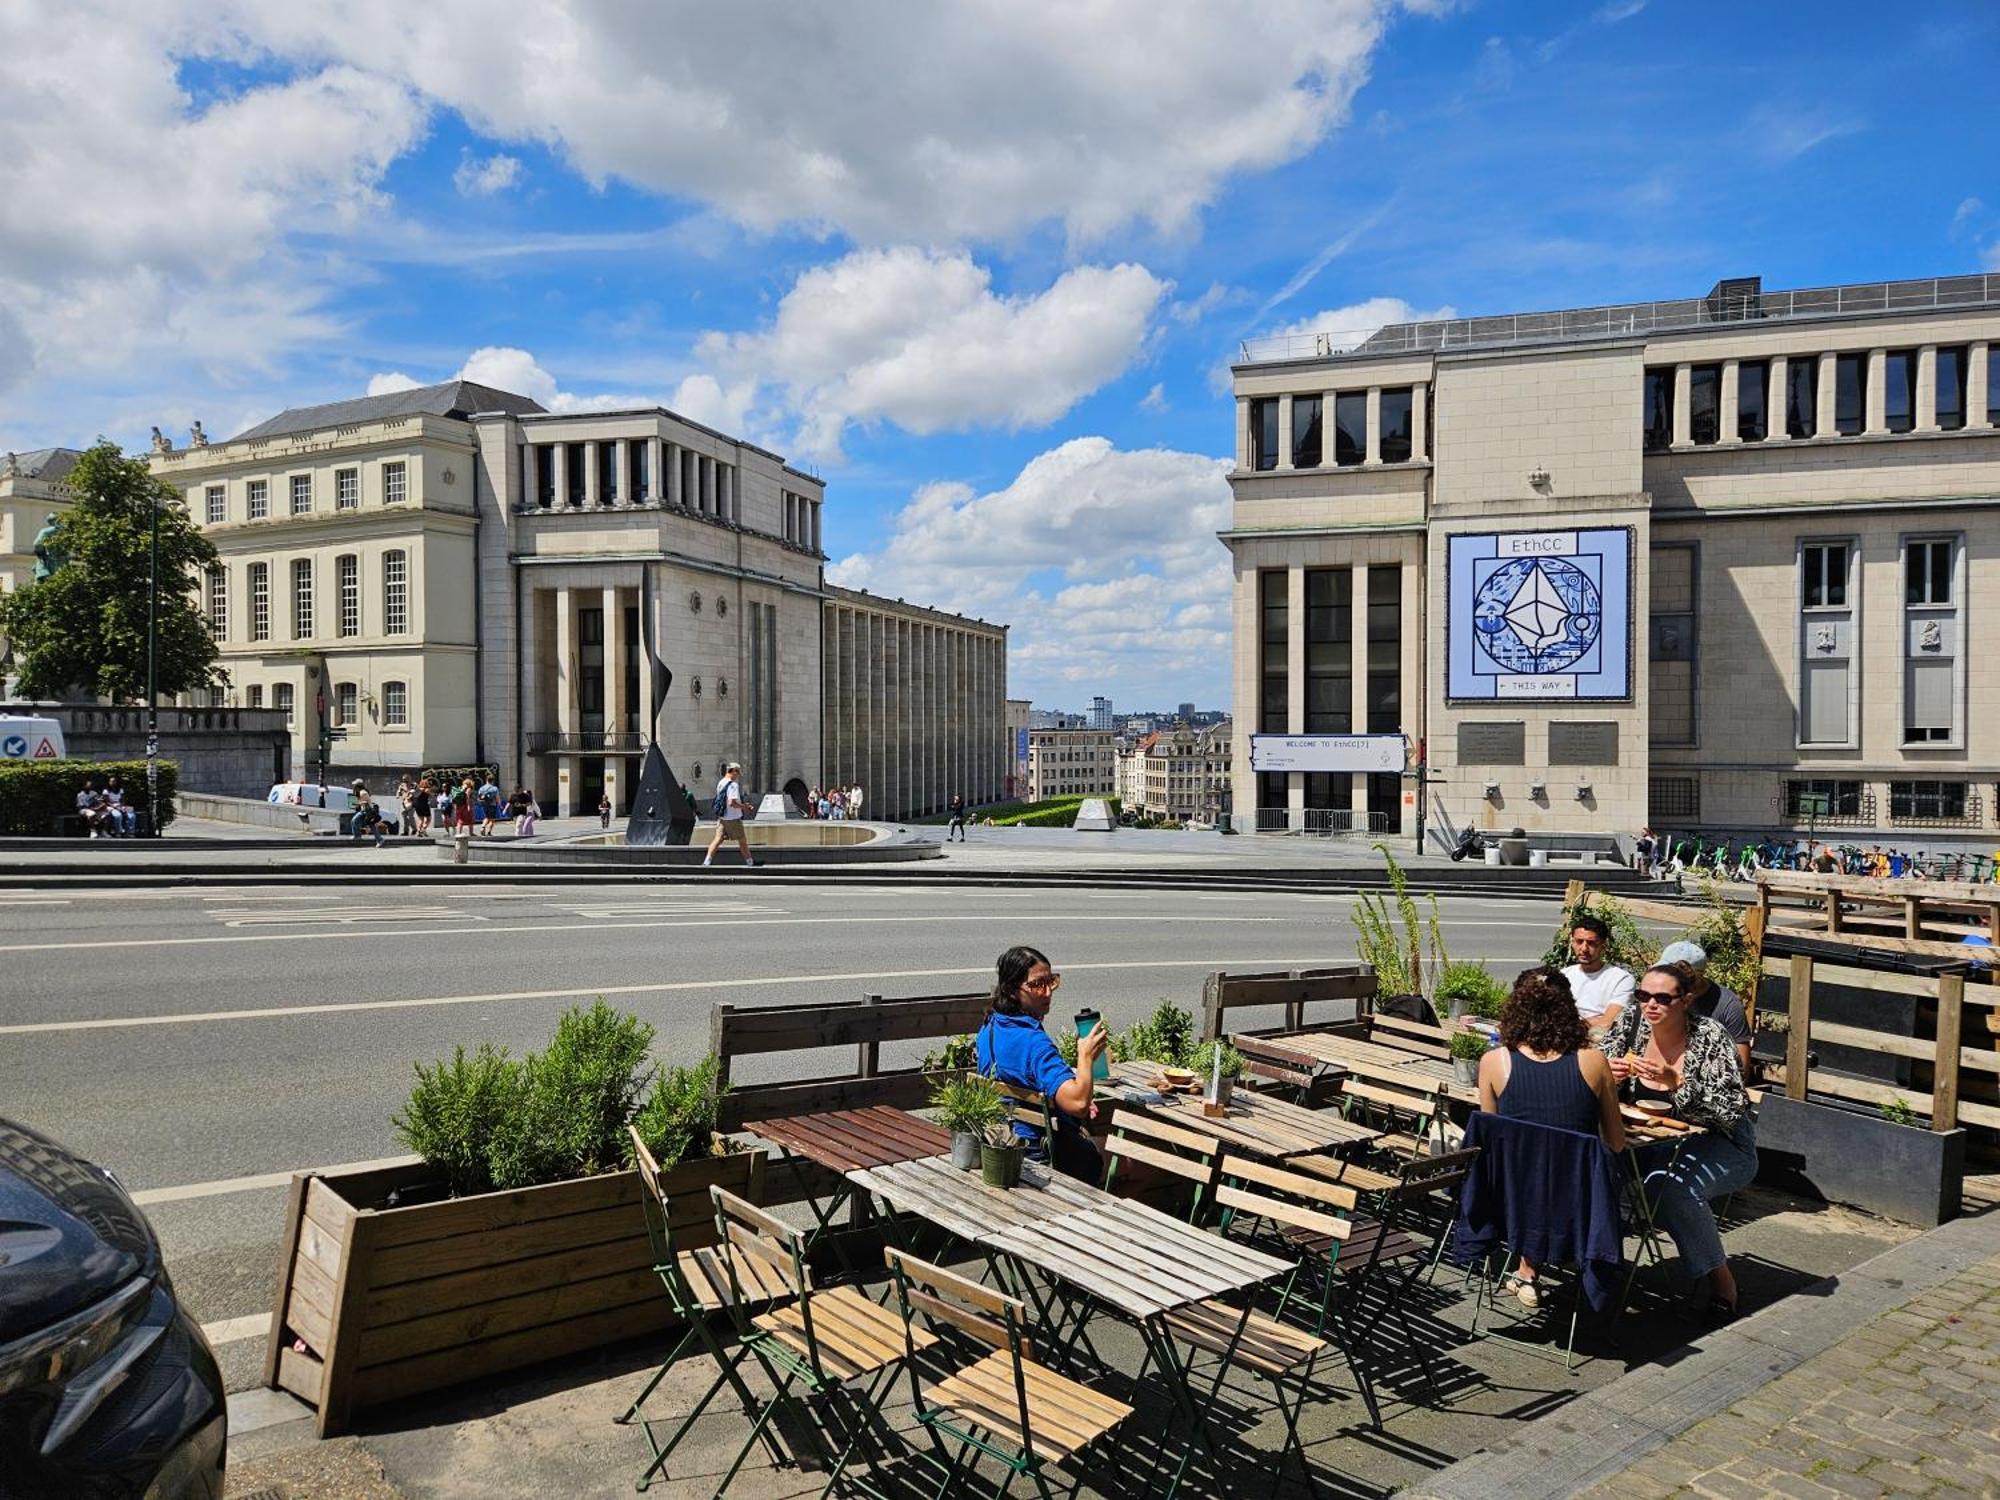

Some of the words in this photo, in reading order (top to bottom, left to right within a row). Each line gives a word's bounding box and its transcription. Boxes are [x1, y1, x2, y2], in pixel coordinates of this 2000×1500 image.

[1512, 538, 1562, 552] EthCC
[1512, 682, 1537, 690] THIS
[1542, 682, 1560, 690] WAY
[1322, 740, 1330, 748] TO
